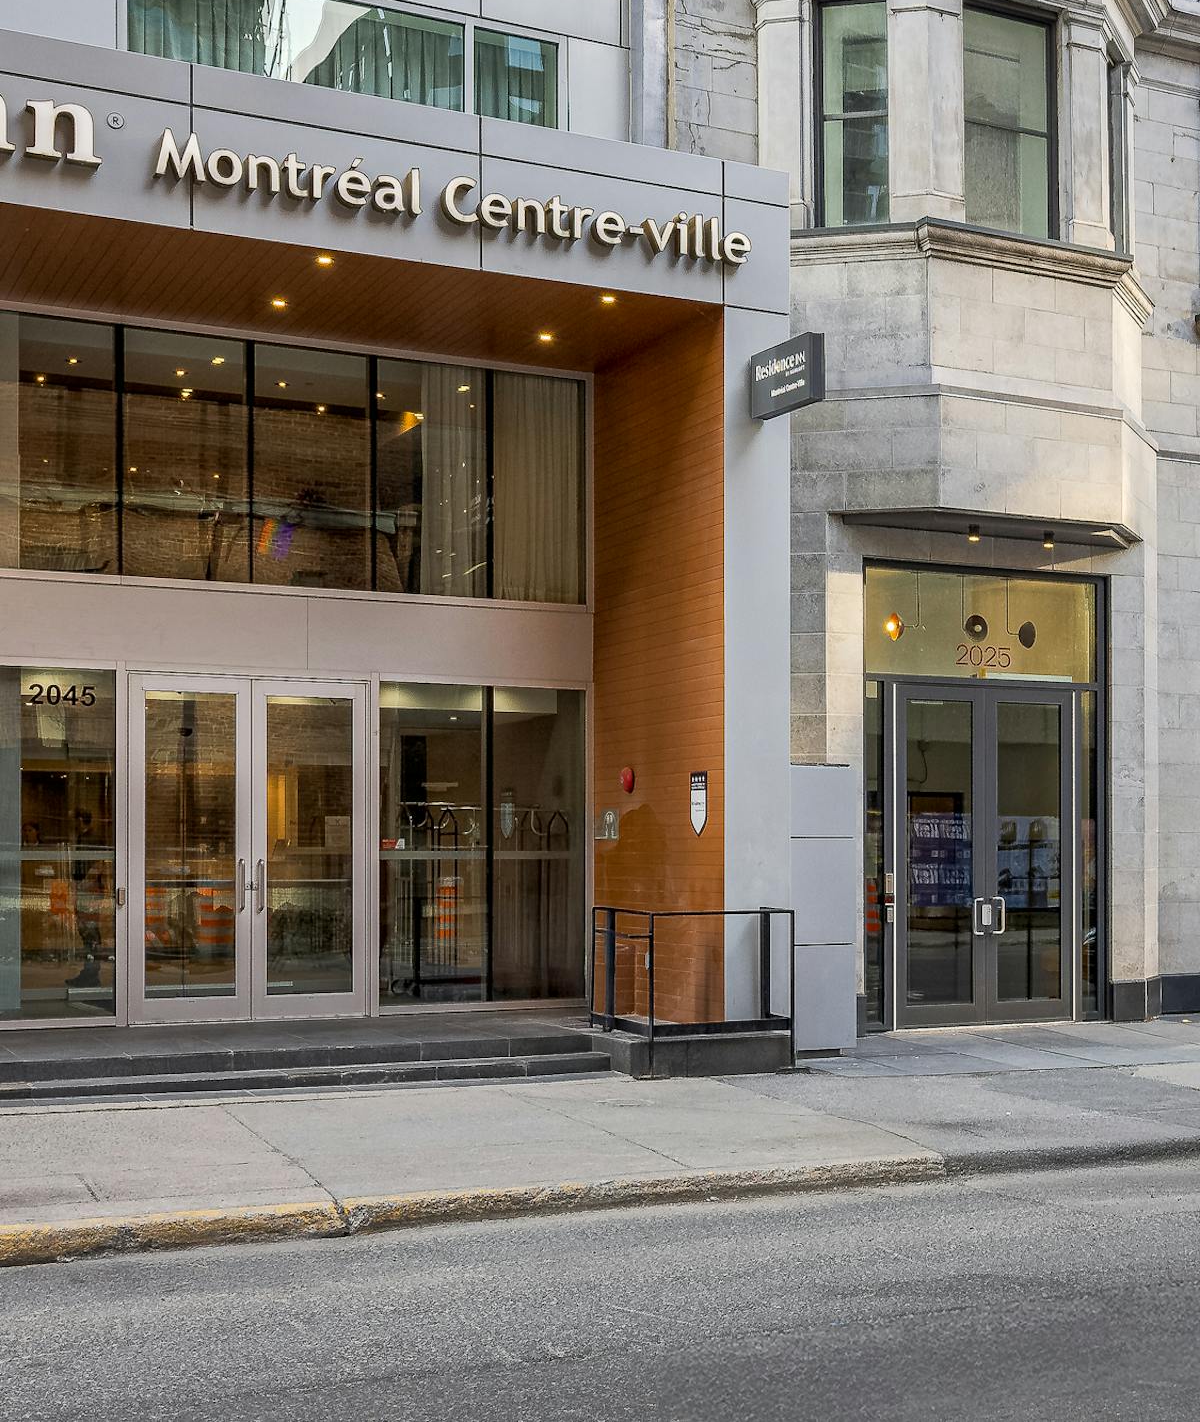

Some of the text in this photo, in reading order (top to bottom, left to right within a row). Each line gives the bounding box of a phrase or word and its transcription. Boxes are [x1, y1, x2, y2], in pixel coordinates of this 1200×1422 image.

[0, 92, 102, 169] n
[152, 126, 752, 265] Montréal Centre-ville
[756, 355, 795, 381] Residence
[955, 643, 1012, 669] 2025
[28, 683, 97, 707] 2045
